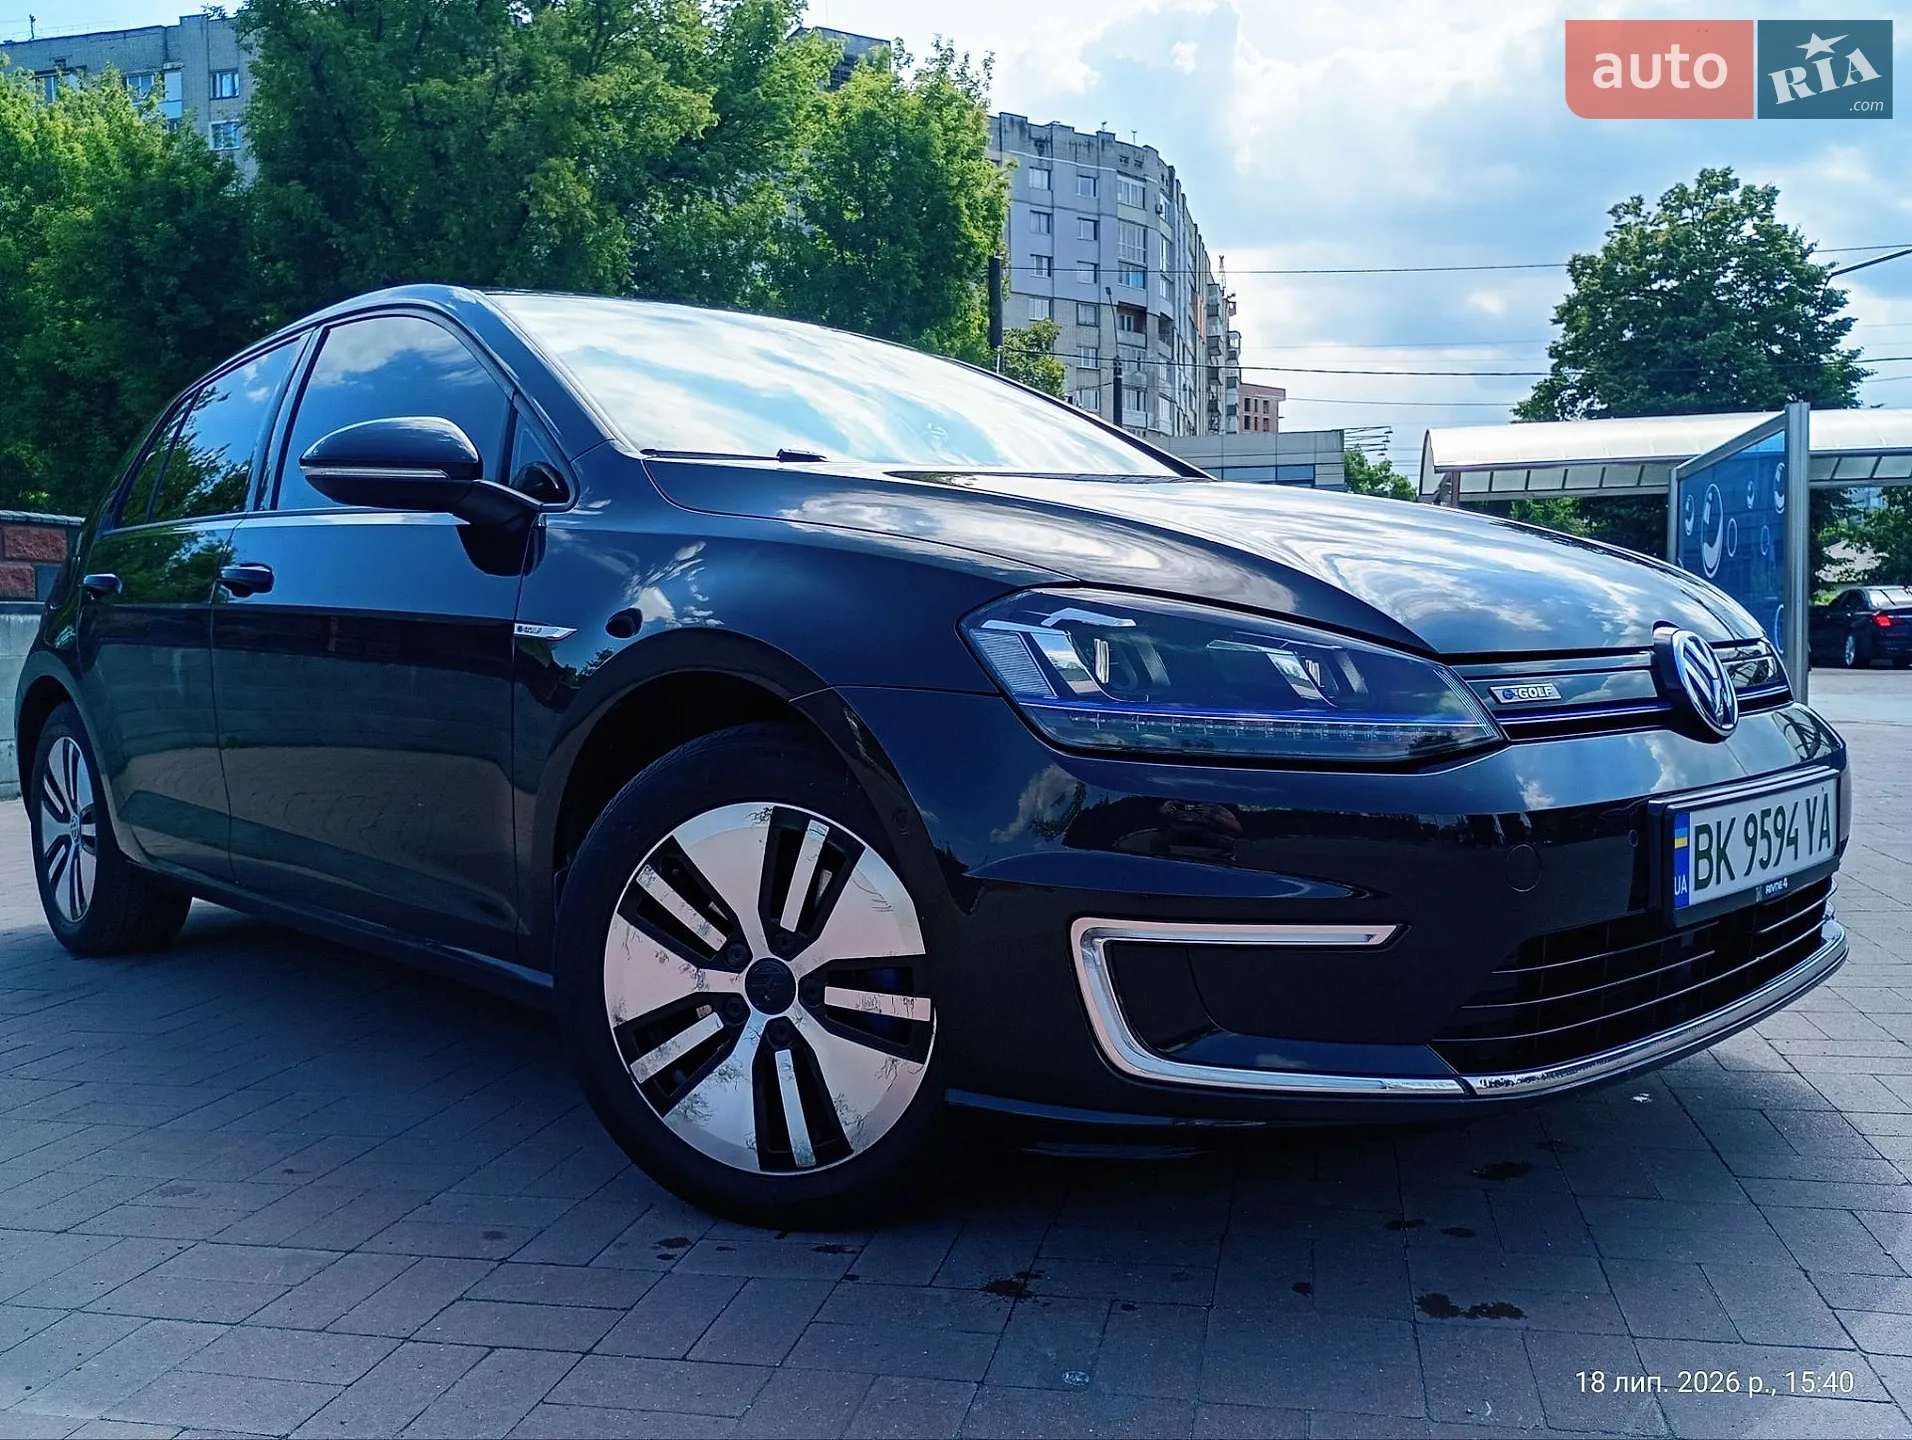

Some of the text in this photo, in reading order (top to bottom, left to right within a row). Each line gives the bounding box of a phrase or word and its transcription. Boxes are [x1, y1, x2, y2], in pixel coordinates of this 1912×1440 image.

[1694, 792, 1831, 891] BK 9594 YA
[1674, 875, 1688, 896] UA
